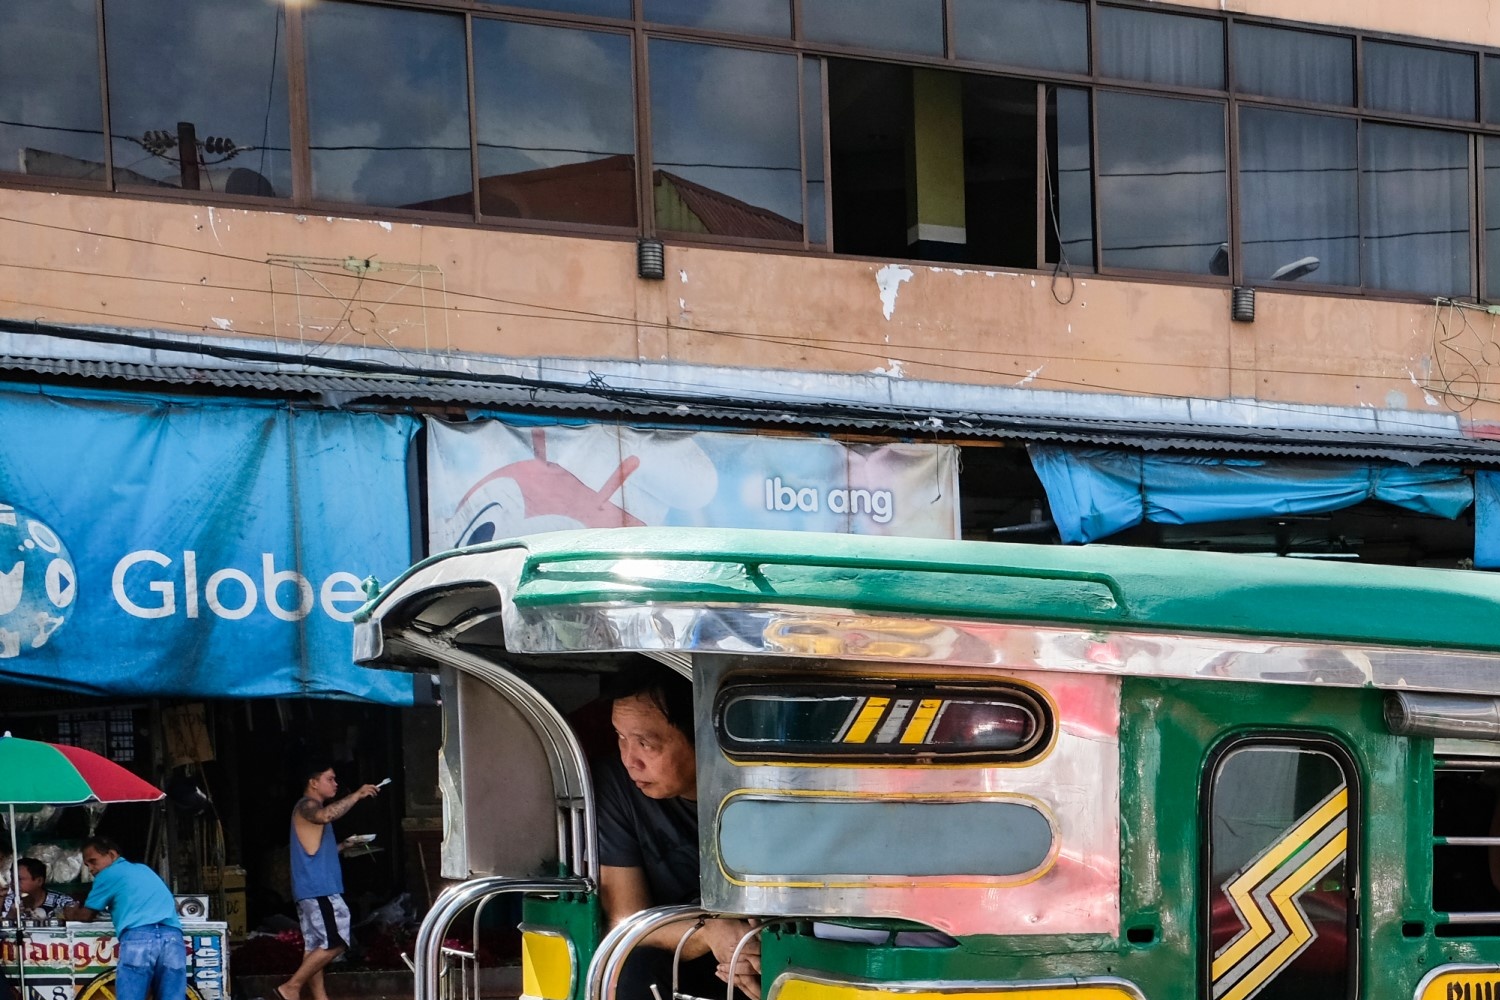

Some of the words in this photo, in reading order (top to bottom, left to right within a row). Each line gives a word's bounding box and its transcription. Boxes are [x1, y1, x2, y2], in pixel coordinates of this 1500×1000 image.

[765, 477, 819, 512] Iba
[827, 487, 893, 523] ang
[111, 549, 367, 622] Globe
